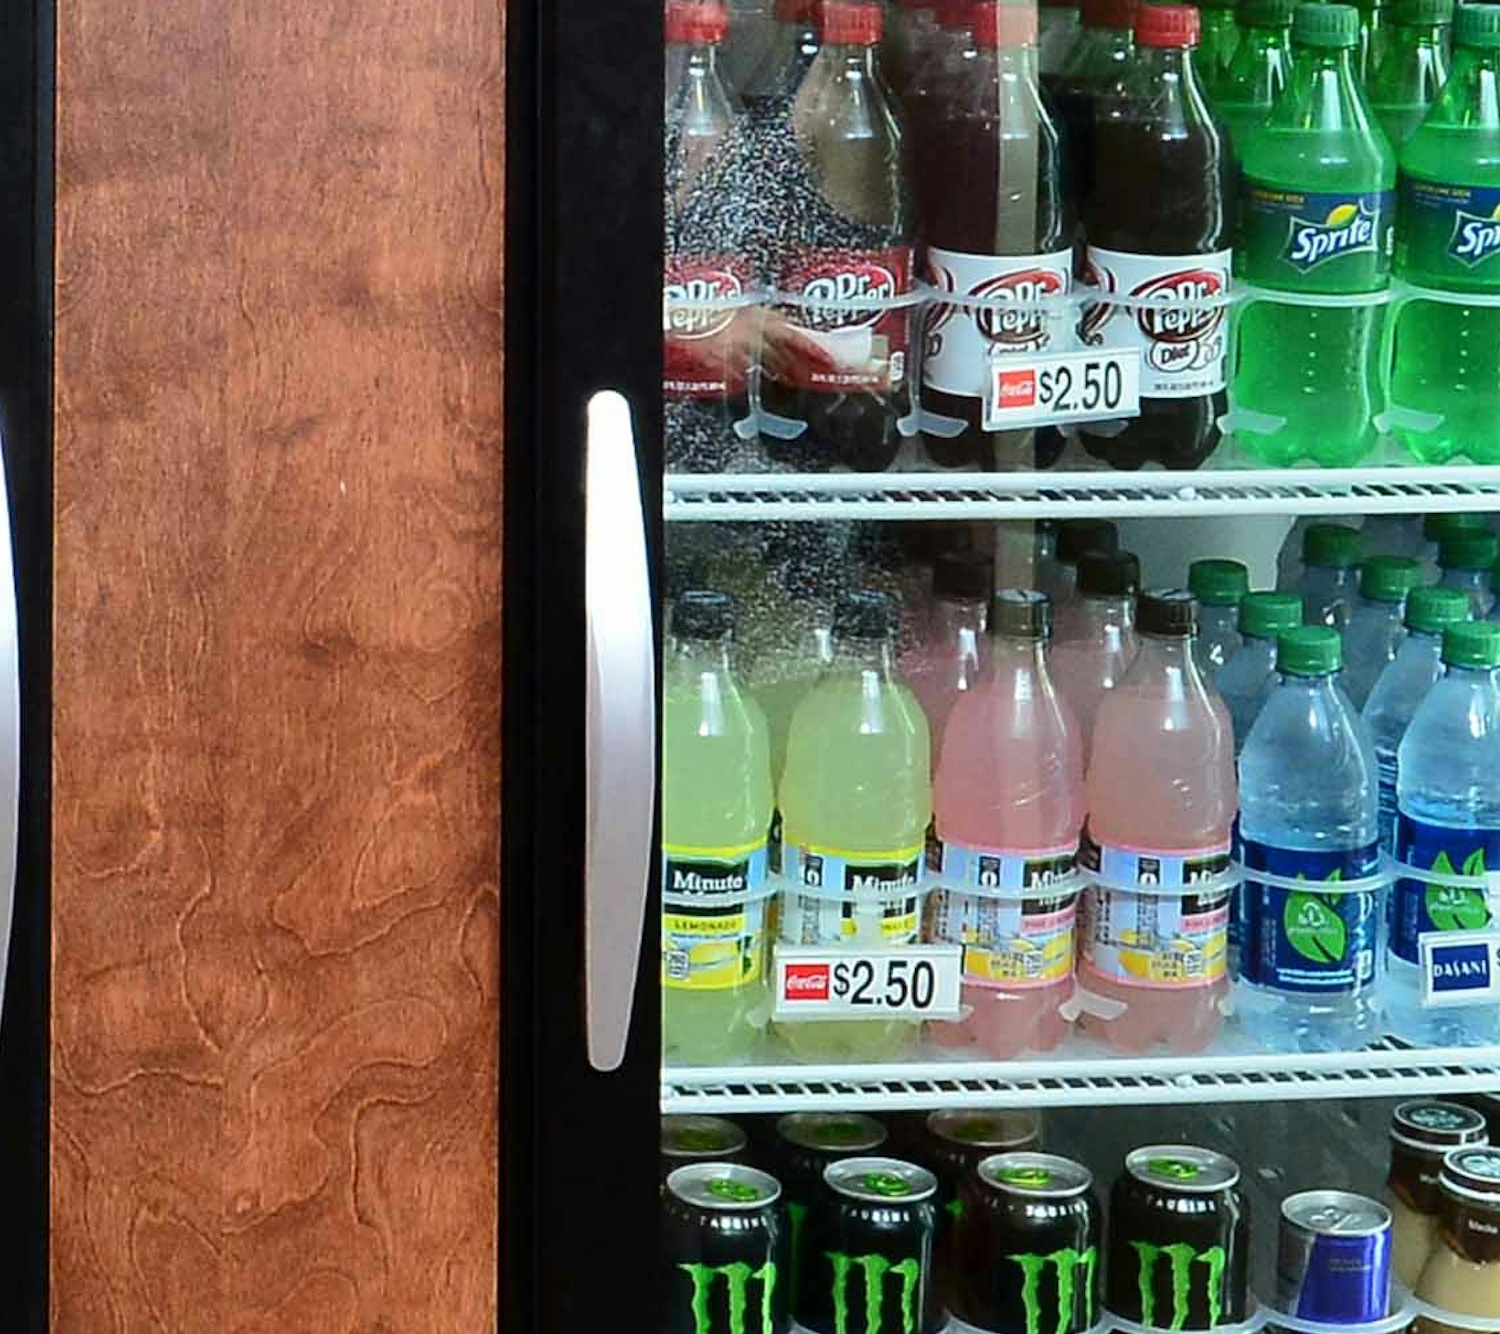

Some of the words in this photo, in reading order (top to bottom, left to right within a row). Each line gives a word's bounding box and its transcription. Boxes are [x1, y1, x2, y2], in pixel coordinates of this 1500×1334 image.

[1291, 218, 1374, 262] Sprite
[1038, 359, 1123, 413] $2.50
[673, 870, 745, 892] Minute
[833, 959, 935, 1009] $2.50
[1432, 958, 1488, 978] DASANI
